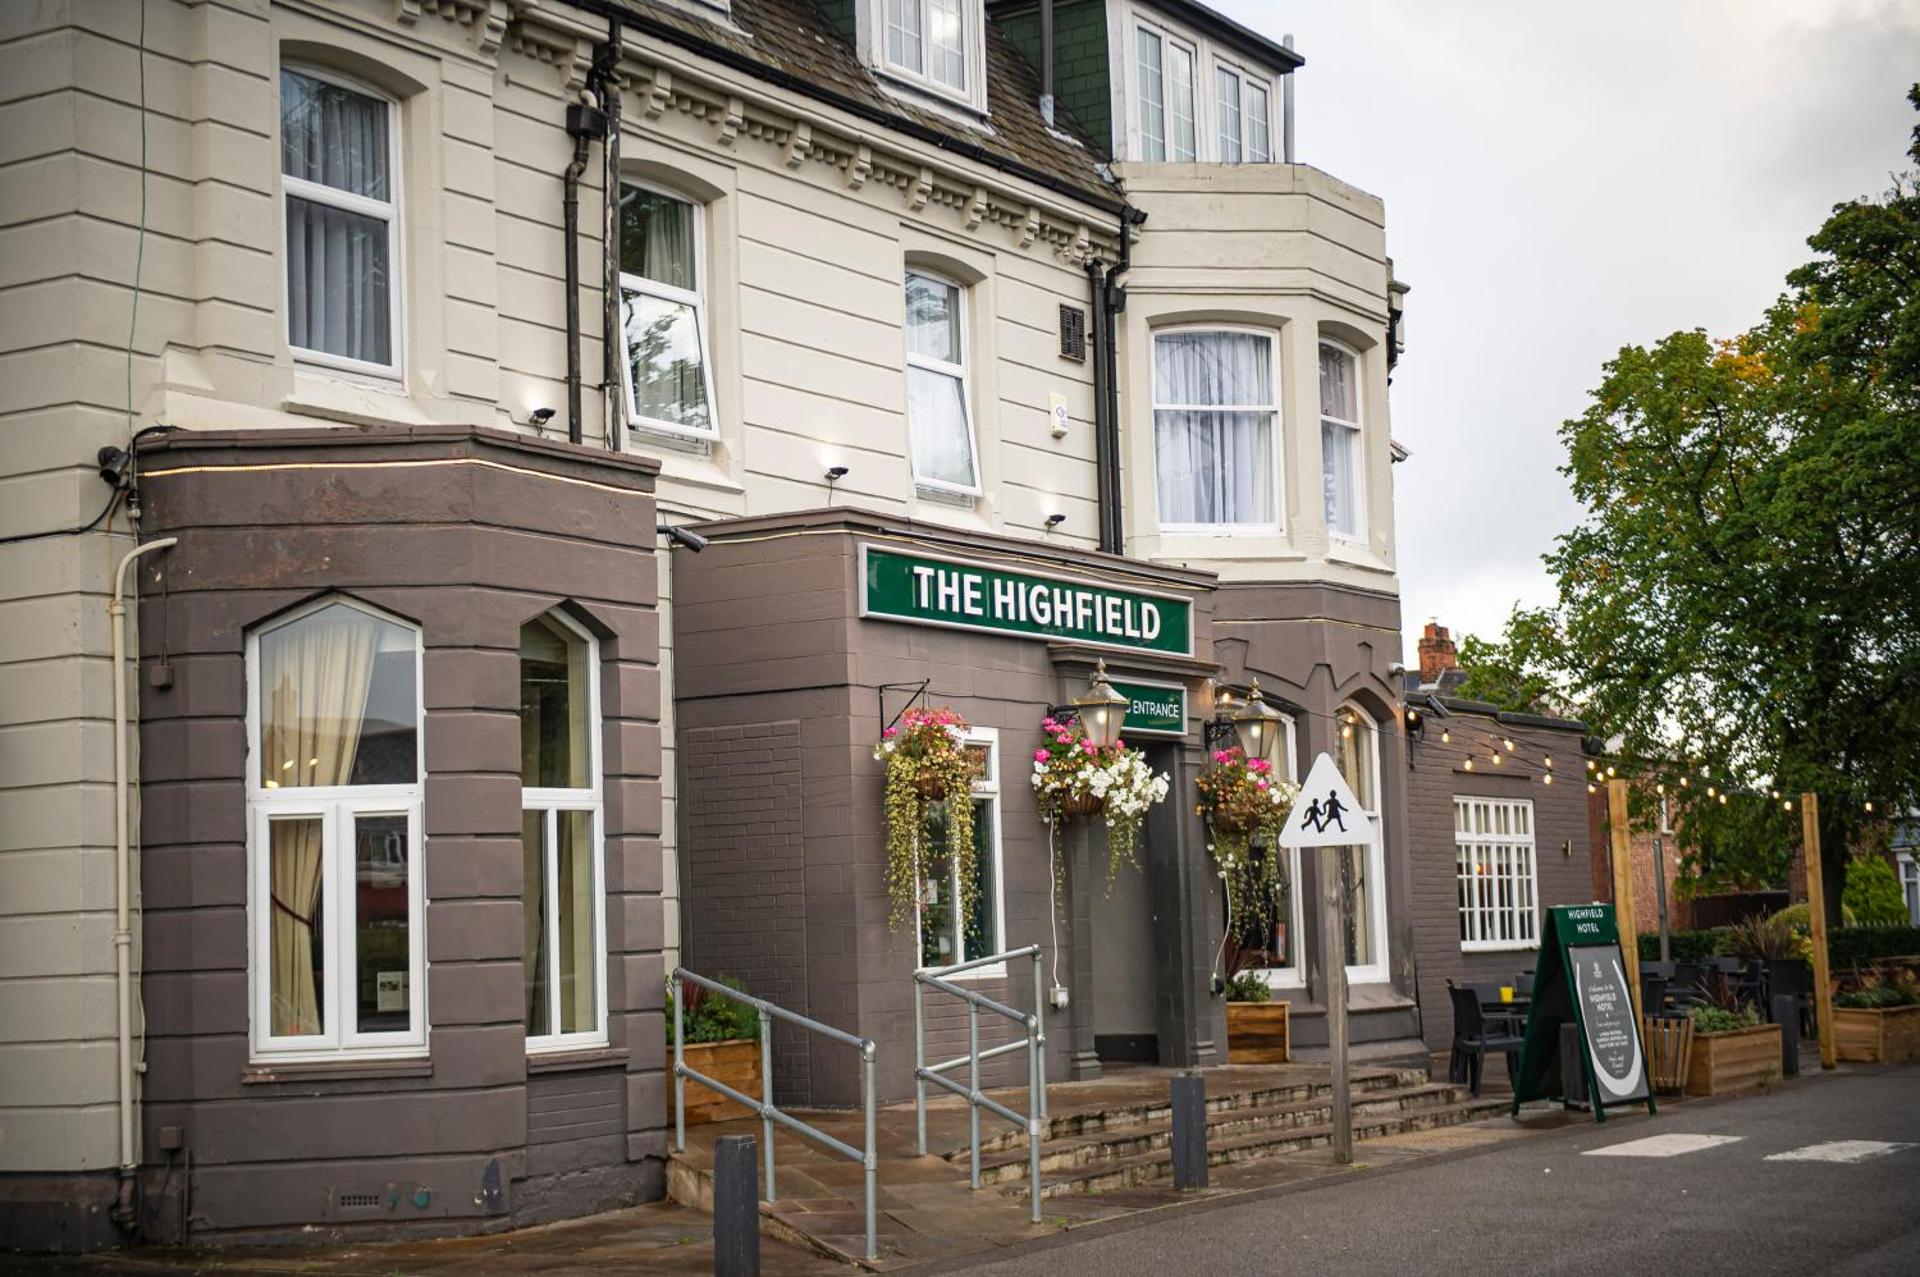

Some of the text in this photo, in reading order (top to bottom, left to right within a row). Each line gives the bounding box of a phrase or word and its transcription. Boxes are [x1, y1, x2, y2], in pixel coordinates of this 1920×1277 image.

[914, 566, 1161, 640] THE HIGHFIELD
[1132, 700, 1179, 718] ENTRANCE
[1568, 908, 1603, 919] HIGHFIELD
[1577, 923, 1599, 933] HOTEL
